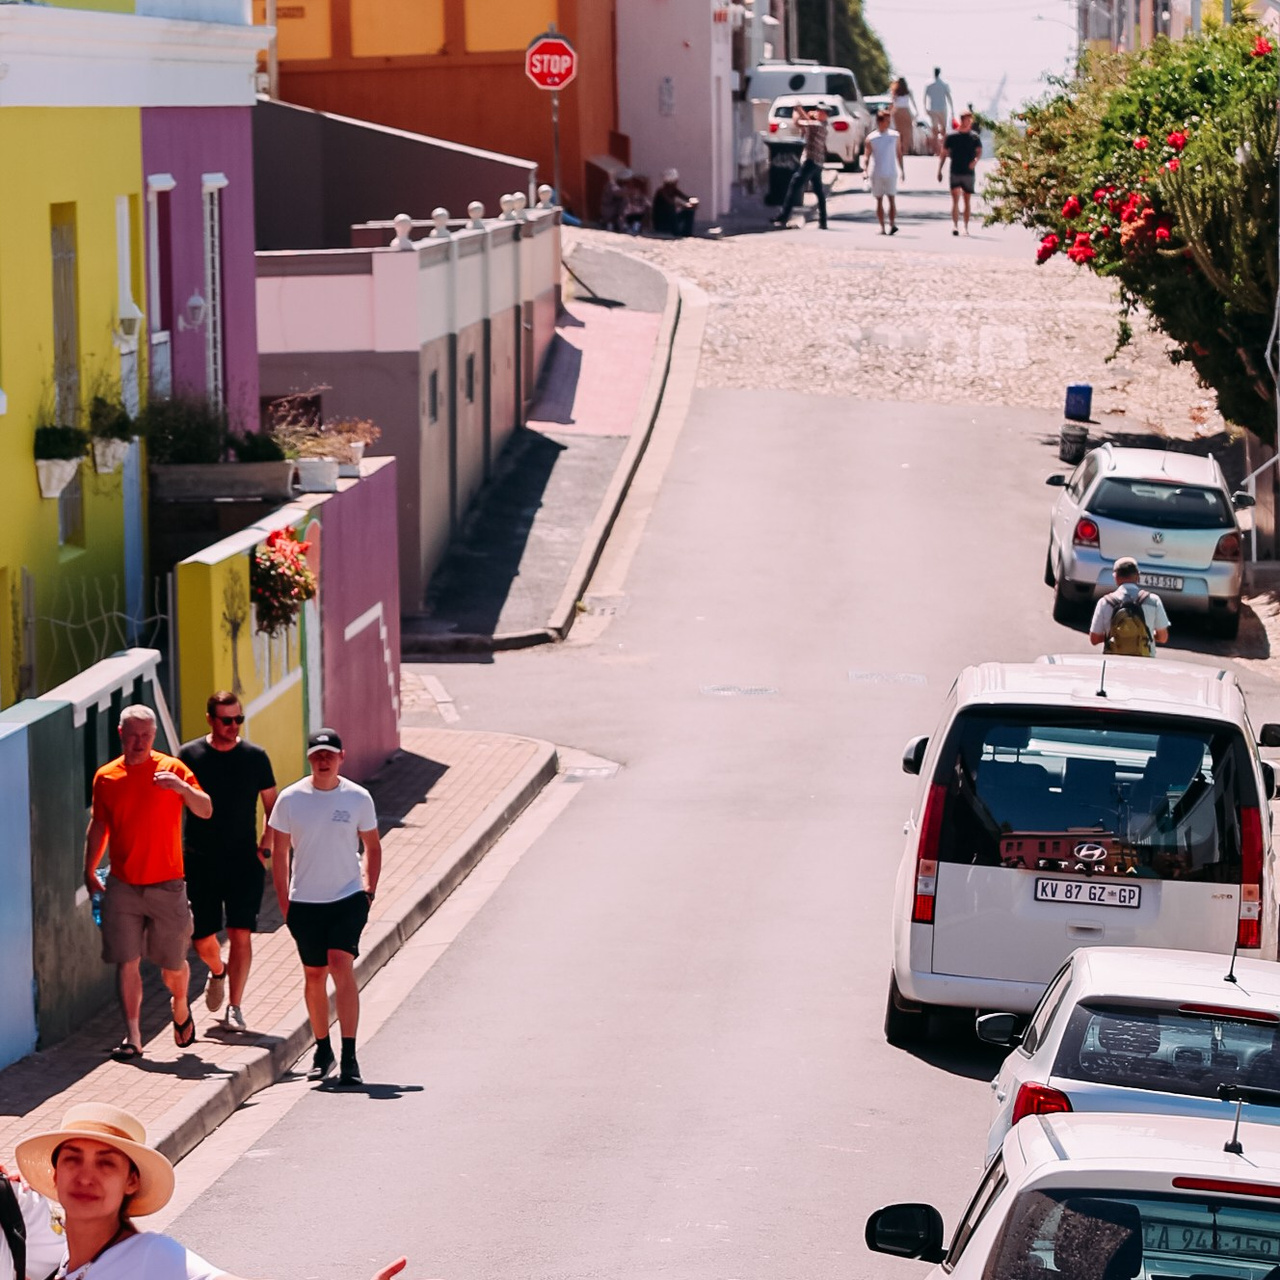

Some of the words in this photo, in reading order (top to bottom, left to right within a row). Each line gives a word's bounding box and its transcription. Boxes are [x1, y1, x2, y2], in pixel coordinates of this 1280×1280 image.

[531, 54, 572, 74] STOP
[1041, 882, 1058, 898] KV
[1065, 884, 1082, 899] 87
[1089, 886, 1106, 902] GZ
[1119, 888, 1136, 904] GP
[1143, 1225, 1169, 1249] CA
